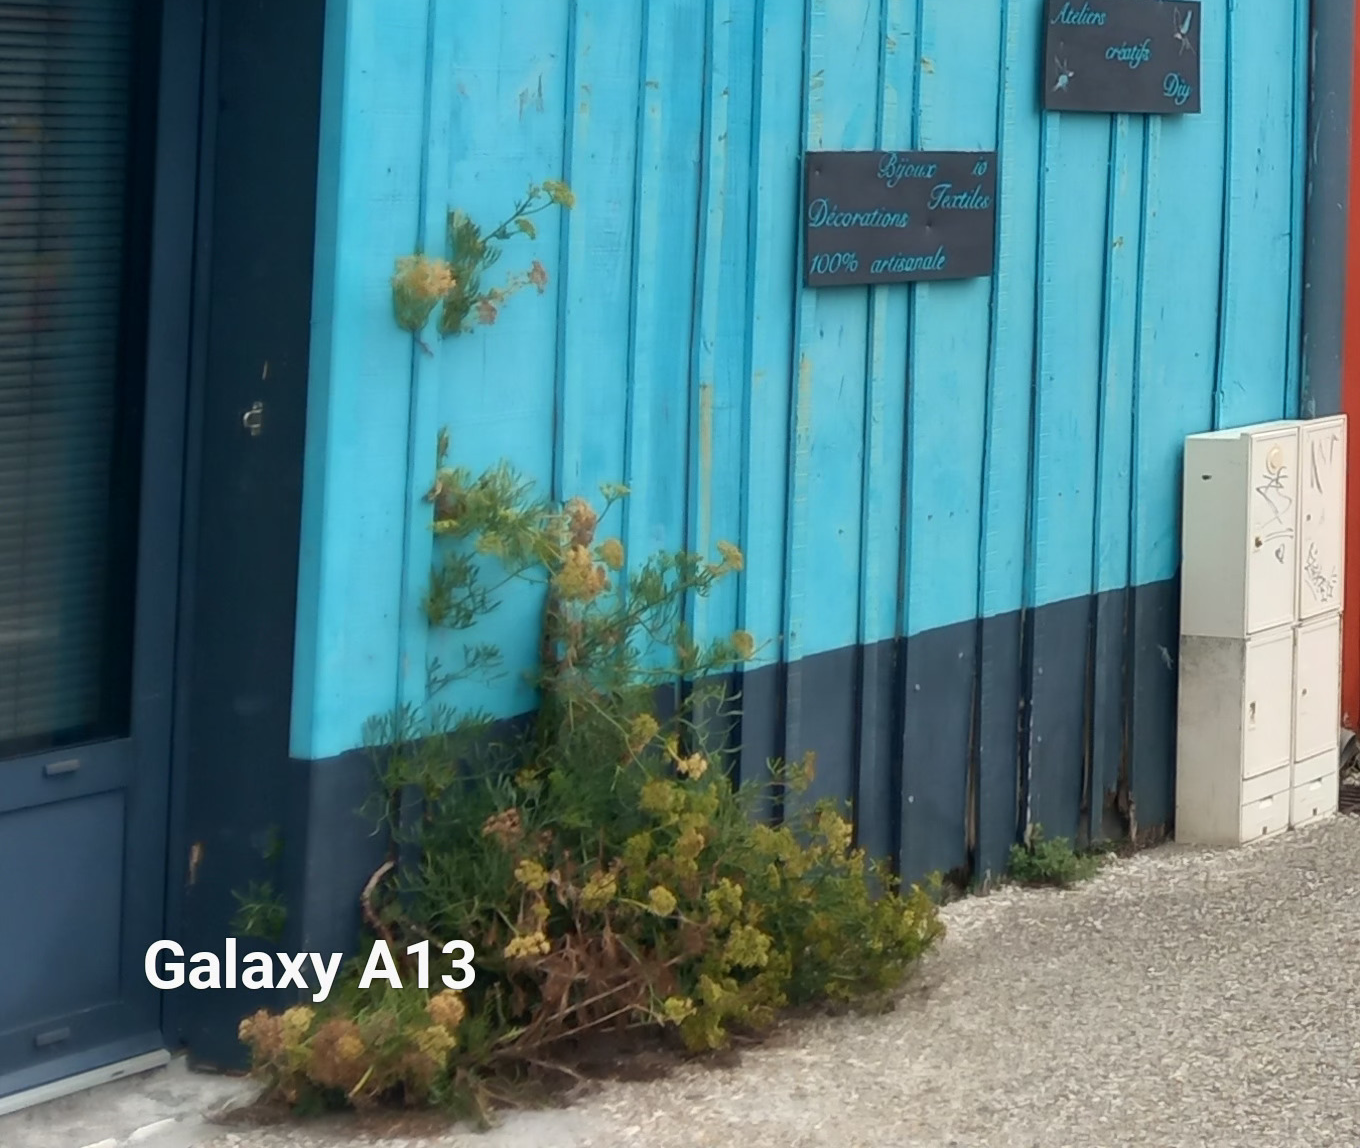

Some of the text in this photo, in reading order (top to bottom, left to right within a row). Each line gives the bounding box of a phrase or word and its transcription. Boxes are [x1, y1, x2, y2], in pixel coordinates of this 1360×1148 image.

[1051, 2, 1106, 25] Ateliers
[1105, 38, 1151, 69] créatifs
[876, 152, 937, 188] Bijoux
[927, 183, 991, 210] Textiles
[808, 198, 909, 228] Décorations
[809, 245, 946, 274] 100% artisanale
